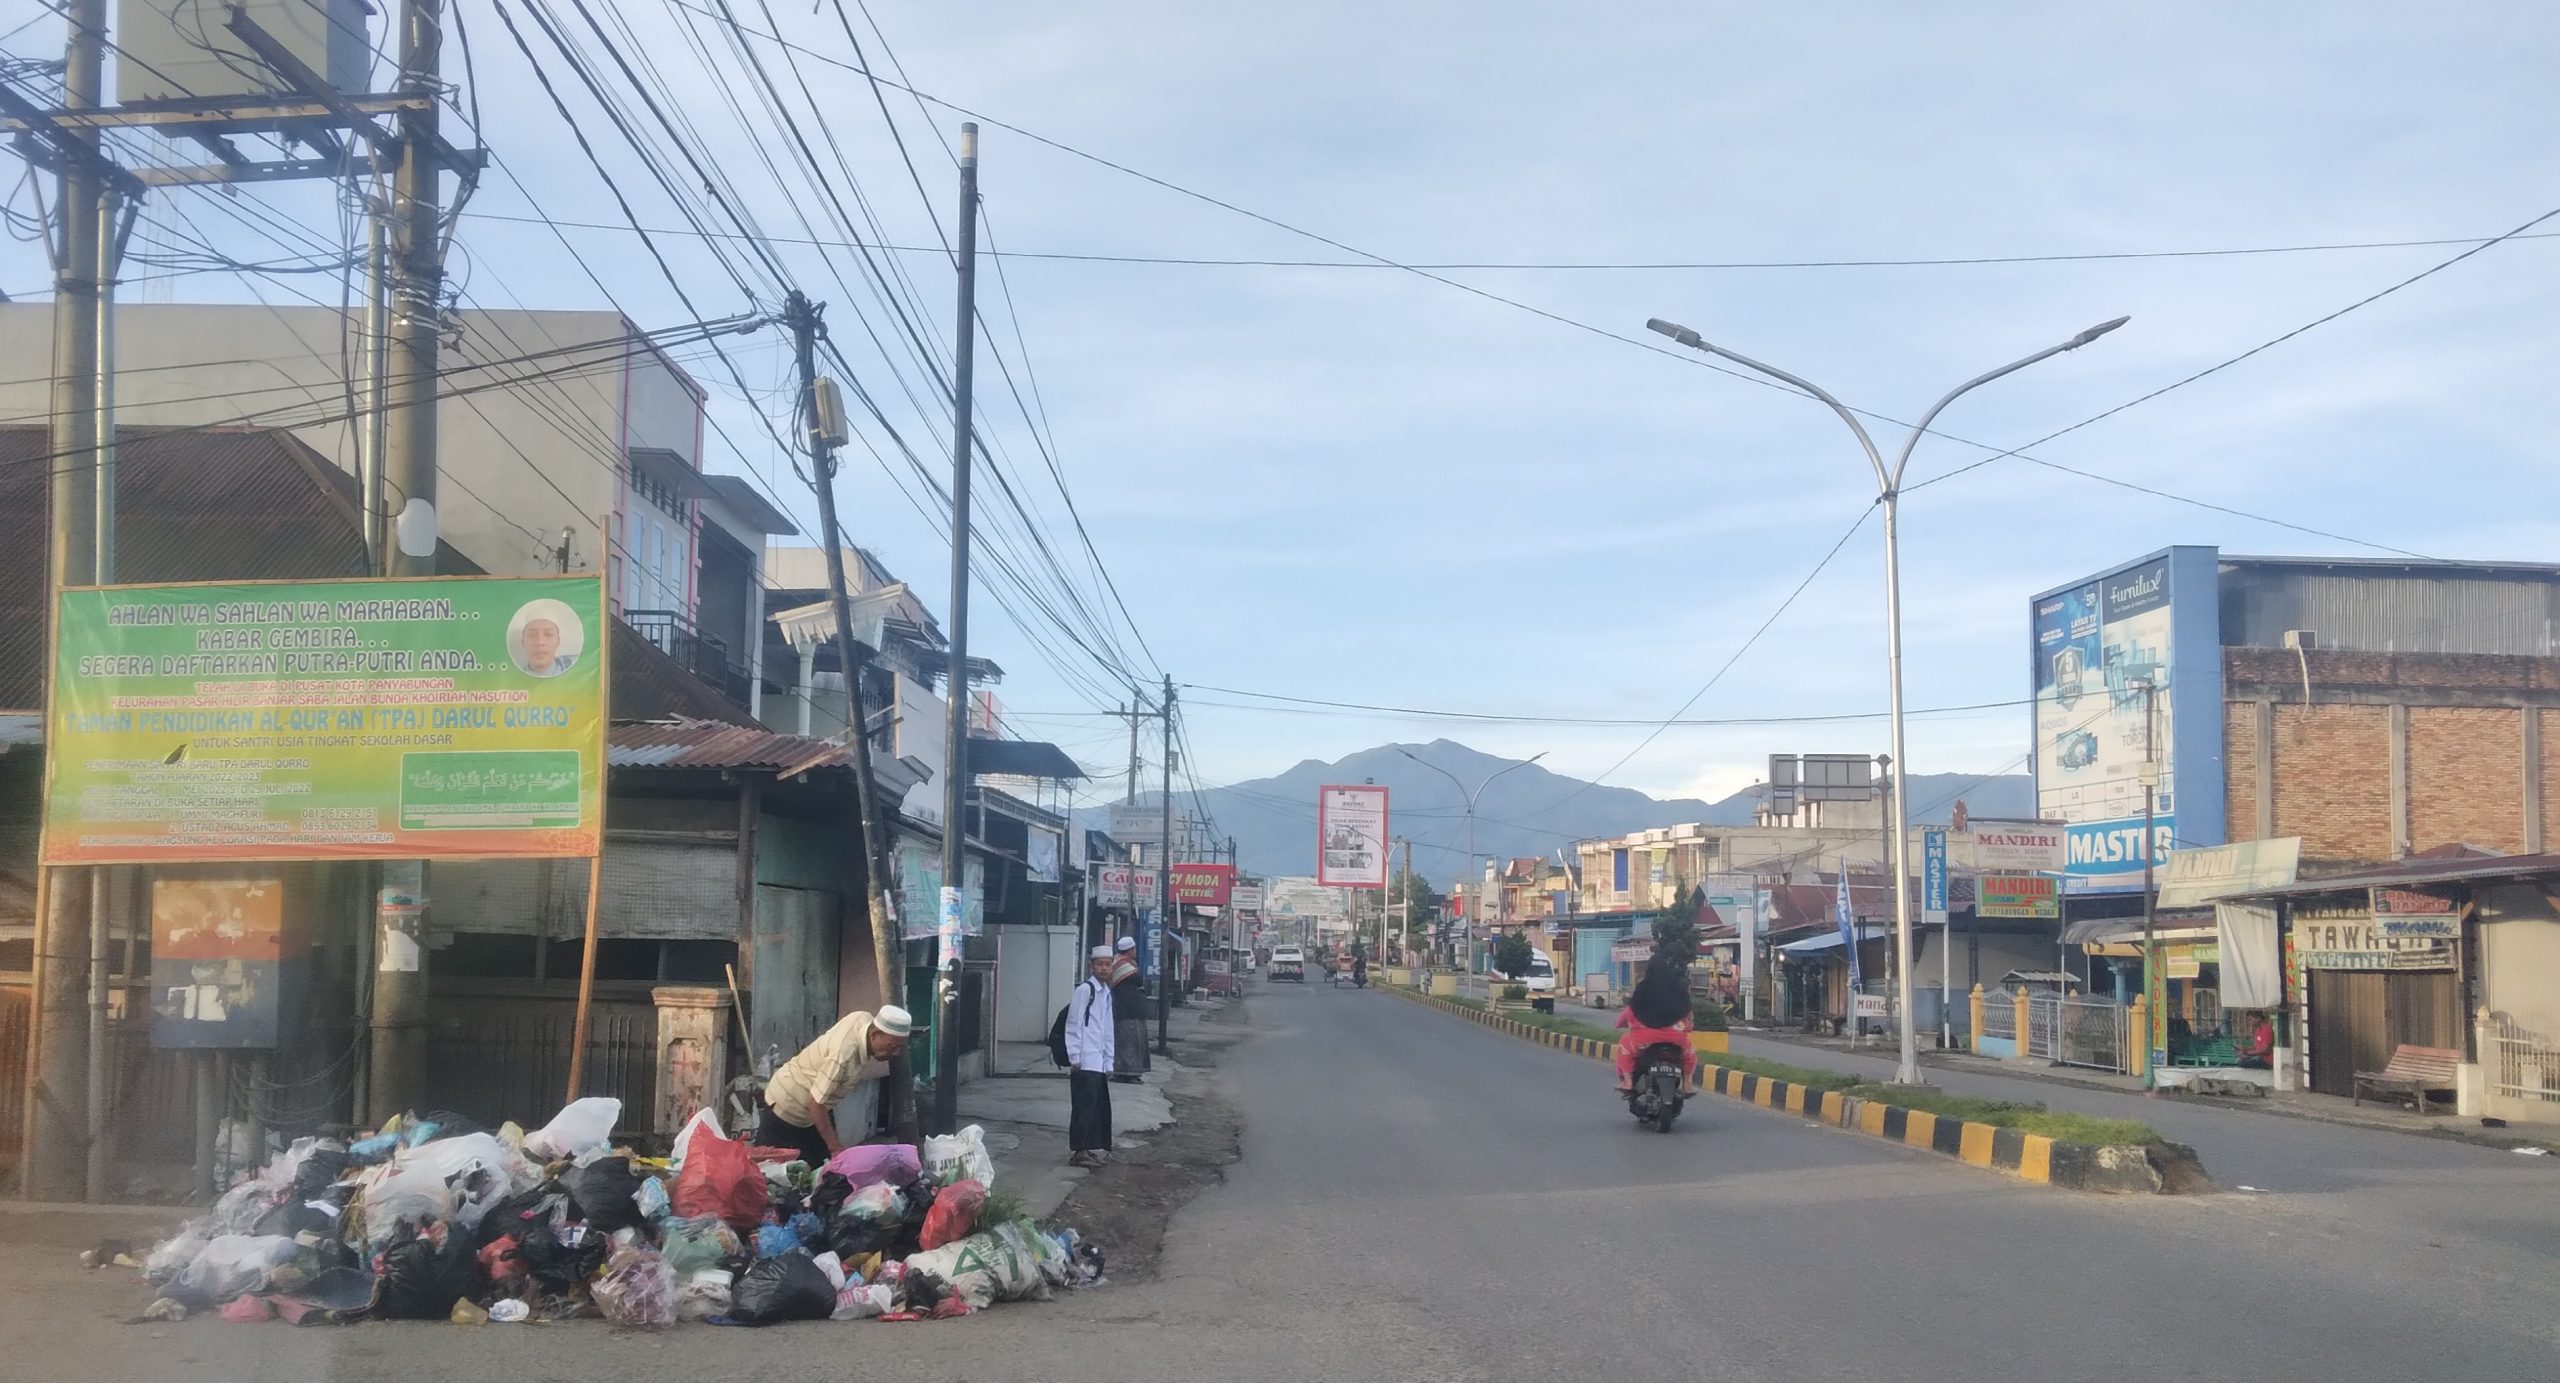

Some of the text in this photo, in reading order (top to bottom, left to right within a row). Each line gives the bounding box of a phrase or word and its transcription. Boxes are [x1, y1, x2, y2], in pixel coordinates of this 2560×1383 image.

[2110, 567, 2163, 603] Furnilux
[109, 604, 174, 626] AHLAN
[180, 603, 210, 625] WA
[215, 602, 294, 624] SAHLAN
[300, 602, 330, 622] WA
[197, 630, 262, 651] KABAR
[80, 656, 155, 677] SEGERA
[161, 653, 278, 676] DAFTARKAN
[284, 651, 413, 674] PUTRA-PUTRI
[295, 680, 333, 693] PUSAT
[335, 680, 365, 692] KOTA
[368, 678, 454, 692] PANYABUNGAN
[182, 695, 218, 708] PASAR
[298, 693, 330, 706] SABA
[332, 692, 367, 706] JALAN
[370, 692, 409, 705] BUNDA
[412, 691, 466, 704] KHOIRIAH
[470, 690, 529, 703] NASUTION
[139, 710, 252, 734] PENDIDIKAN
[431, 706, 497, 729] DARUL
[193, 734, 453, 749] UNTUK SANTRI USIA TINGKAT SEKOLAH DASAR
[240, 758, 272, 769] DARUL
[234, 797, 259, 807] HARI
[1978, 834, 2058, 848] MANDIRI
[1185, 874, 1219, 887] MODA
[1929, 848, 1943, 911] MASTER
[1985, 877, 2052, 897] MANDIRI
[1107, 897, 1147, 906] ADVACE
